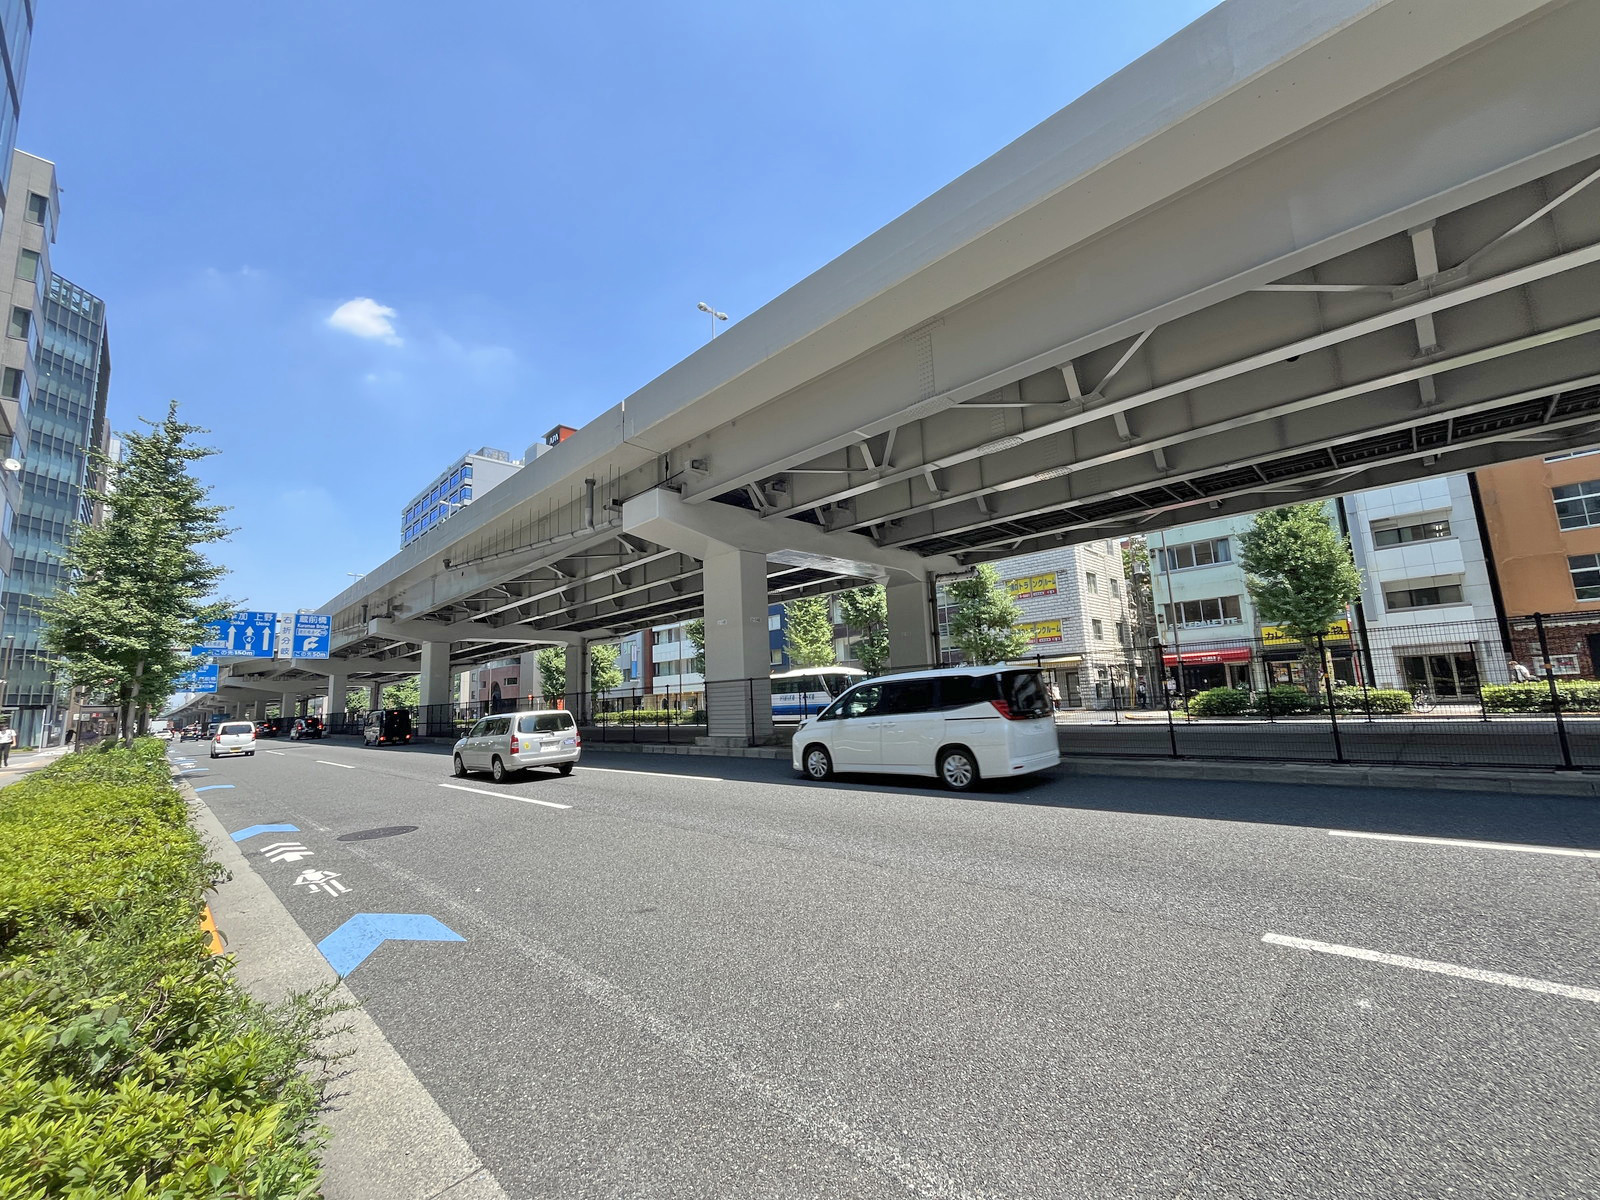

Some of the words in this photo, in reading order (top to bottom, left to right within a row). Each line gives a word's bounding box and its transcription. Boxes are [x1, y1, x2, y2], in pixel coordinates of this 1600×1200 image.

[253, 613, 273, 622] 上野
[280, 616, 292, 655] 右折分岐
